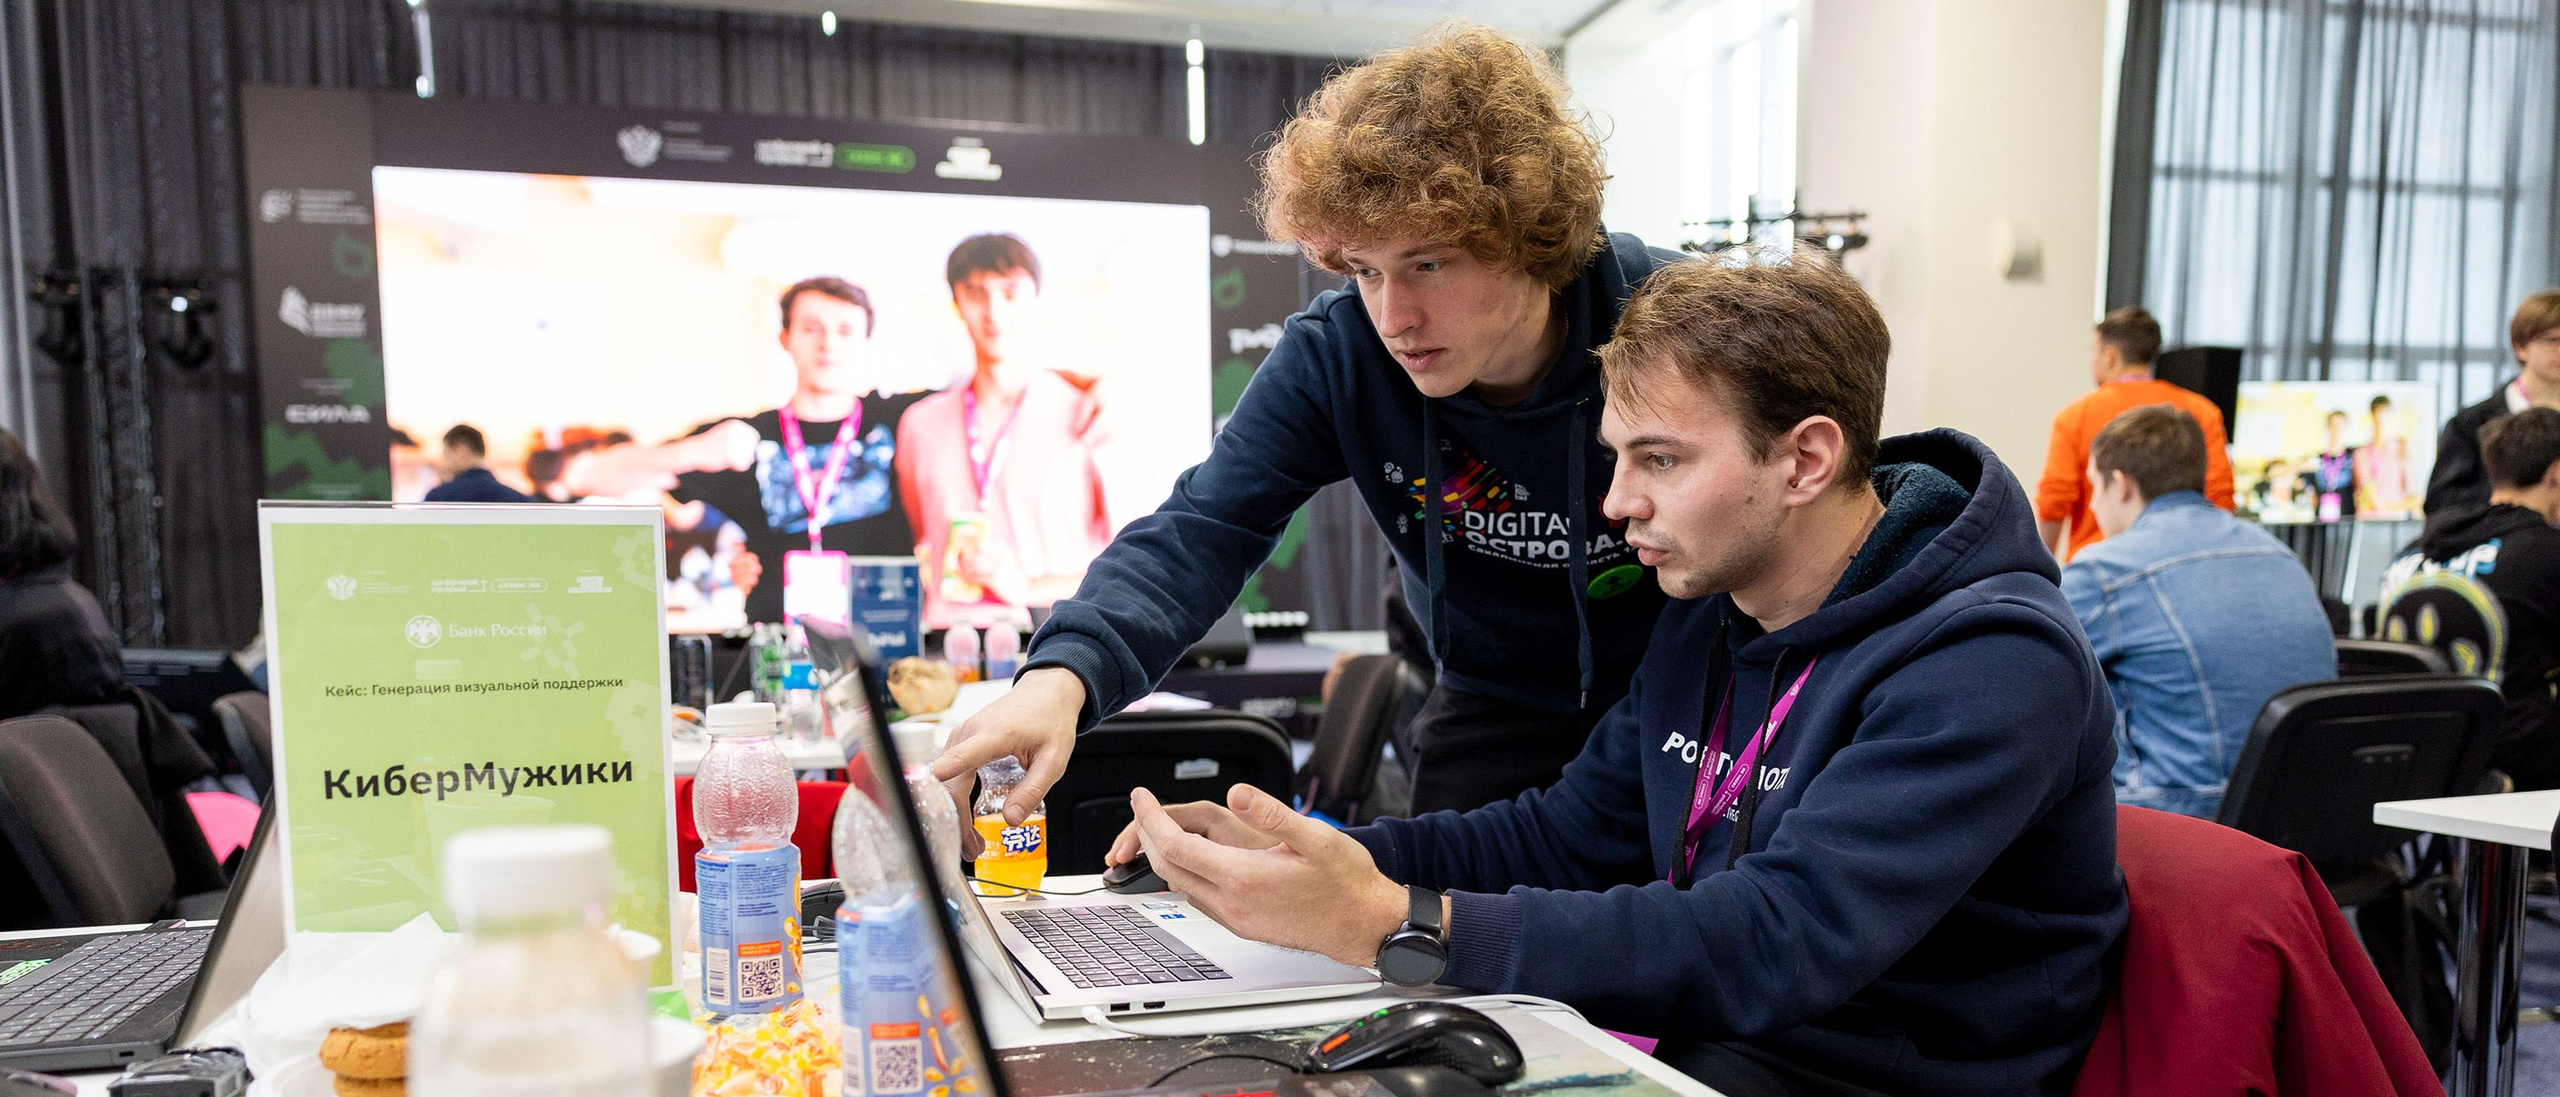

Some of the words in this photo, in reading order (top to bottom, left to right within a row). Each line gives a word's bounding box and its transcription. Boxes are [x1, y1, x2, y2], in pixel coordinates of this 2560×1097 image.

[1464, 511, 1570, 537] DIGITA
[448, 624, 487, 638] Банк
[491, 623, 547, 637] России
[325, 683, 368, 698] Кейс:
[371, 682, 451, 697] Генерация
[455, 678, 539, 694] визуальной
[543, 676, 623, 691] поддержки
[324, 760, 633, 801] КиберМужики
[1001, 824, 1042, 852] 芬达
